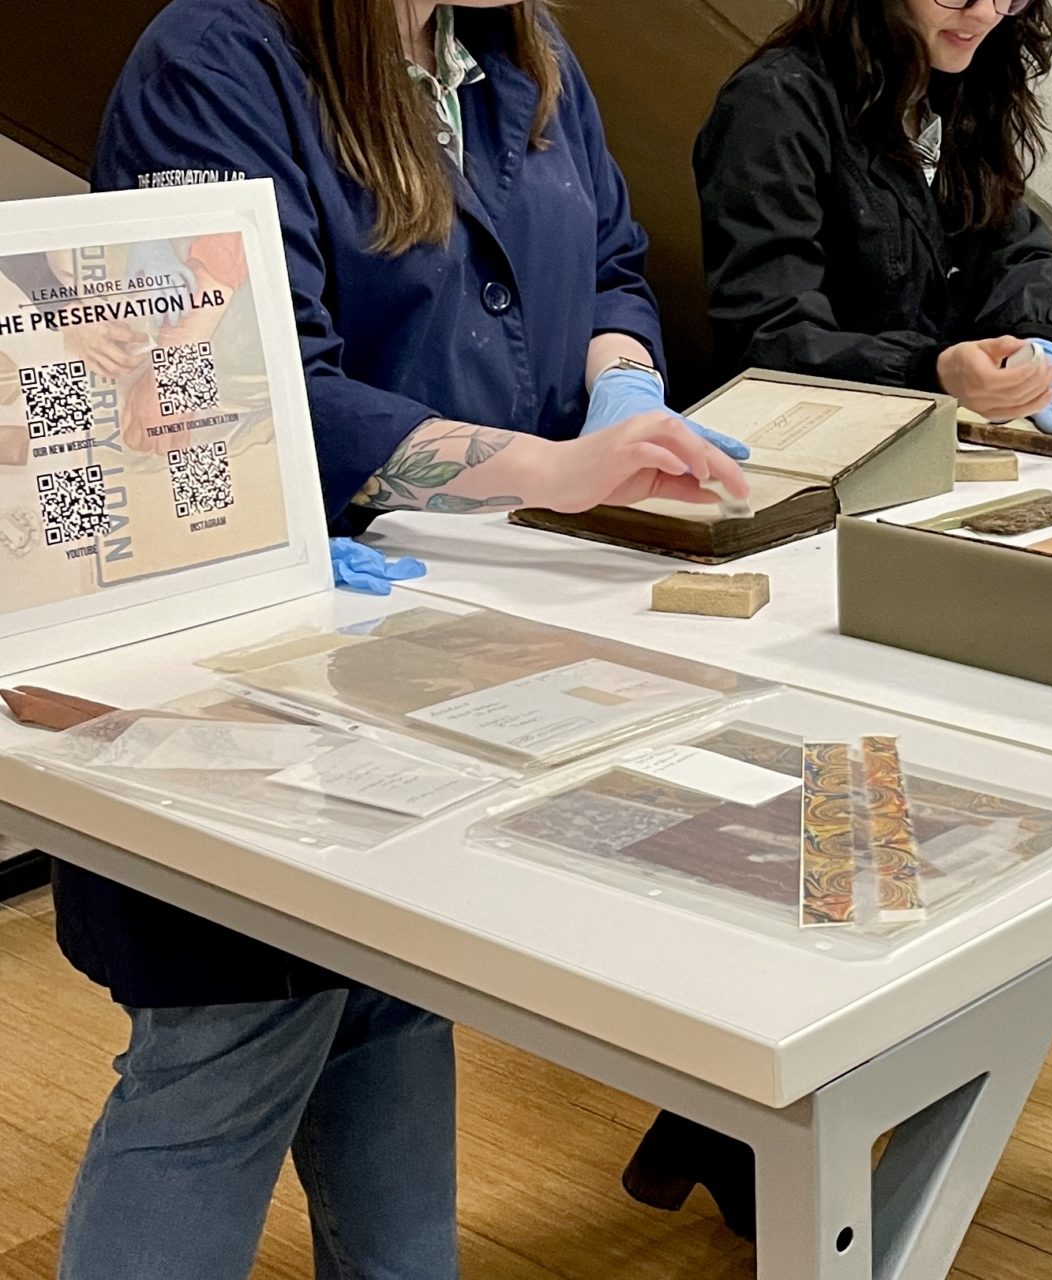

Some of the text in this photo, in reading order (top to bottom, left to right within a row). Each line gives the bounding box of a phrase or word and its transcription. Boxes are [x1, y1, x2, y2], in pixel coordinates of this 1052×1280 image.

[152, 169, 219, 187] PRESERVATION
[31, 274, 172, 301] LEARN MORE ABOUT
[30, 295, 184, 332] PRESERVATION
[190, 289, 225, 309] LAB
[146, 422, 185, 437] TREATMENT
[33, 438, 97, 457] OUR NEW WEBSITE
[190, 516, 226, 532] INSTAGRAM
[65, 544, 98, 559] YOUTUBE
